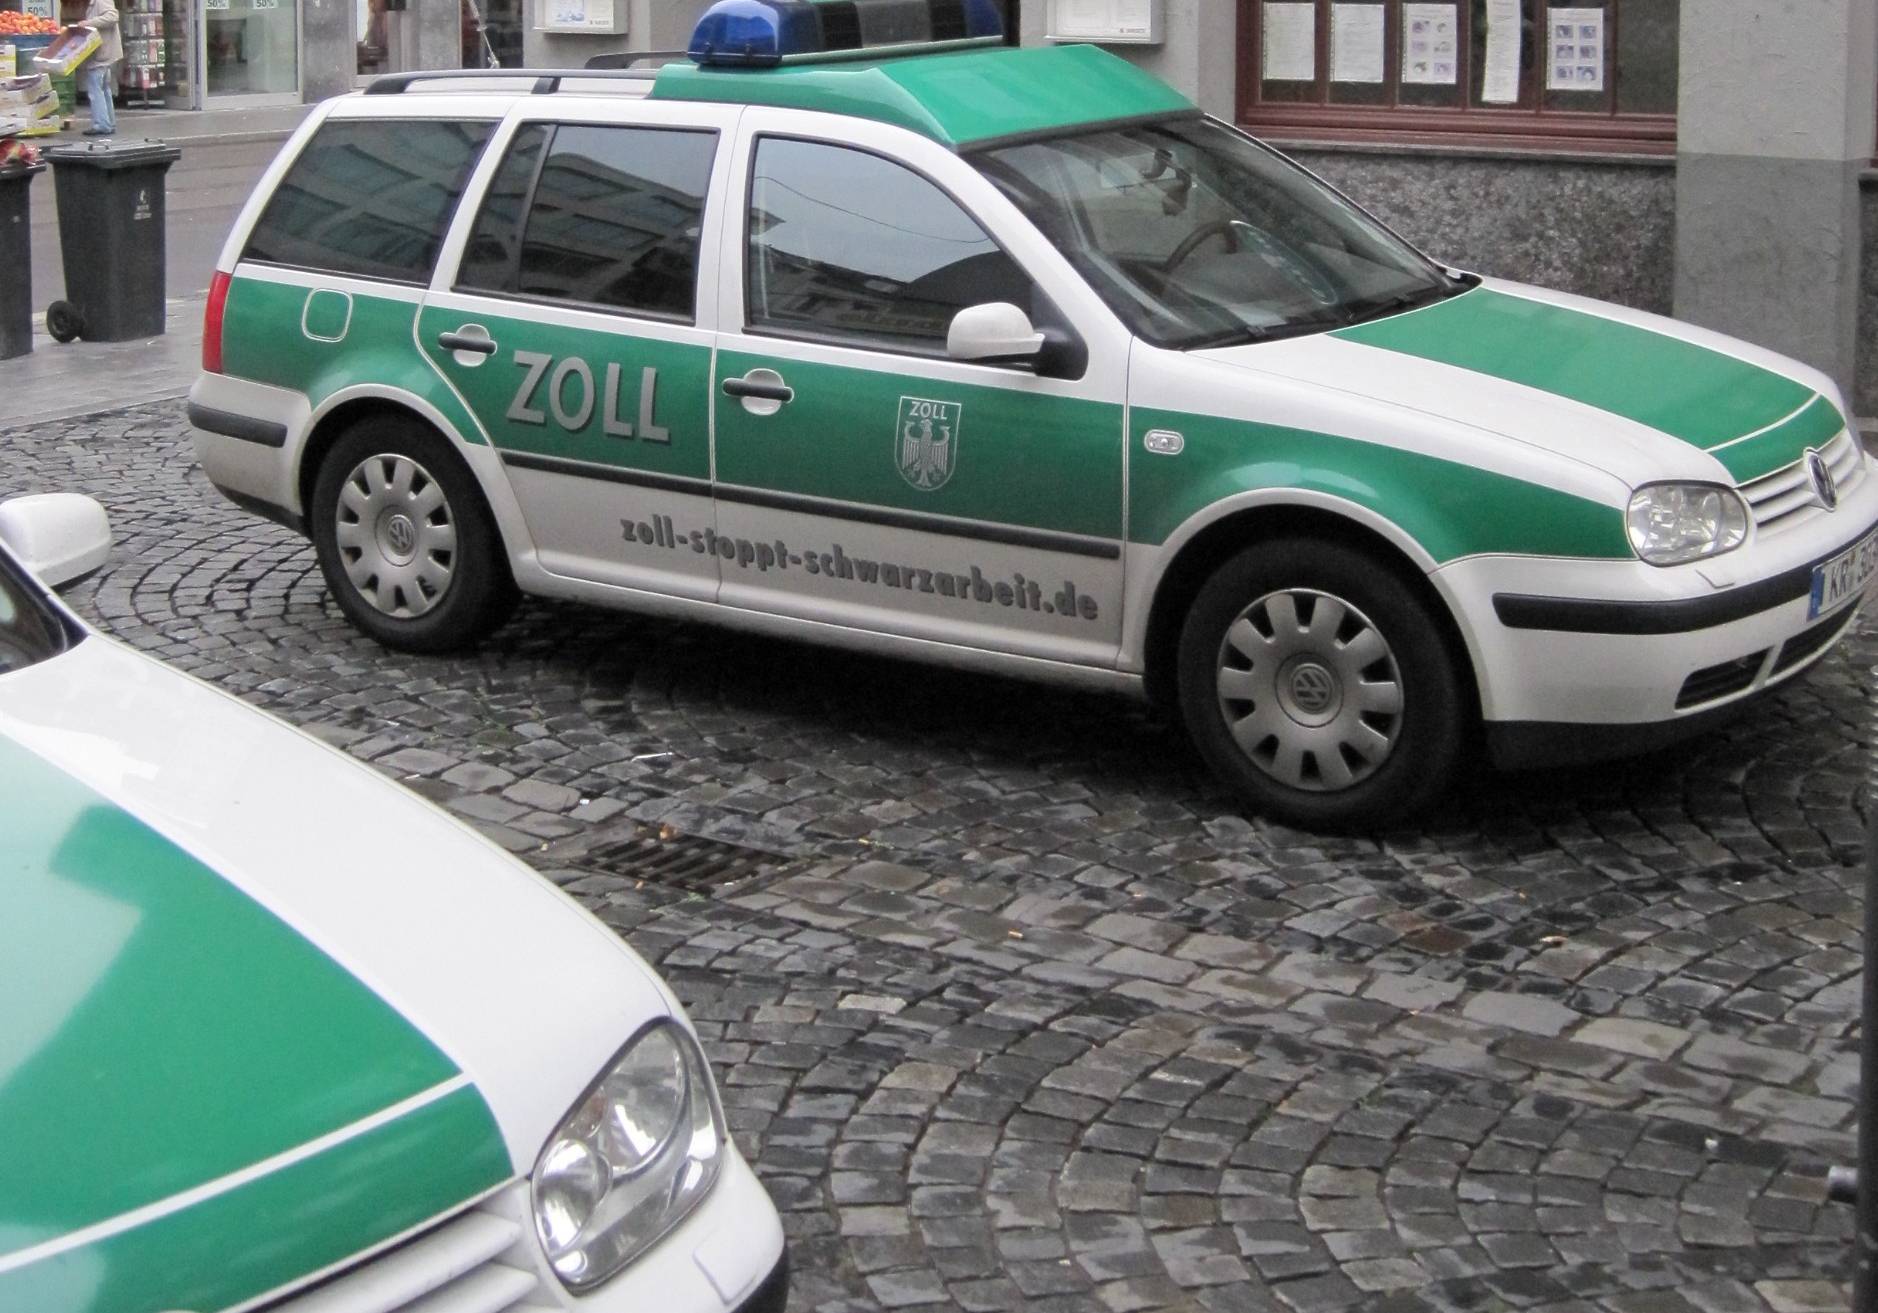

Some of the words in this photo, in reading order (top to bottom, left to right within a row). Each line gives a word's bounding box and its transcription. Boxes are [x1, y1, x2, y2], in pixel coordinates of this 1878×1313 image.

[506, 350, 670, 442] ZOLL
[909, 401, 948, 420] ZOLL
[620, 514, 1098, 620] zoll-stoppt-schwarzarbeit.de
